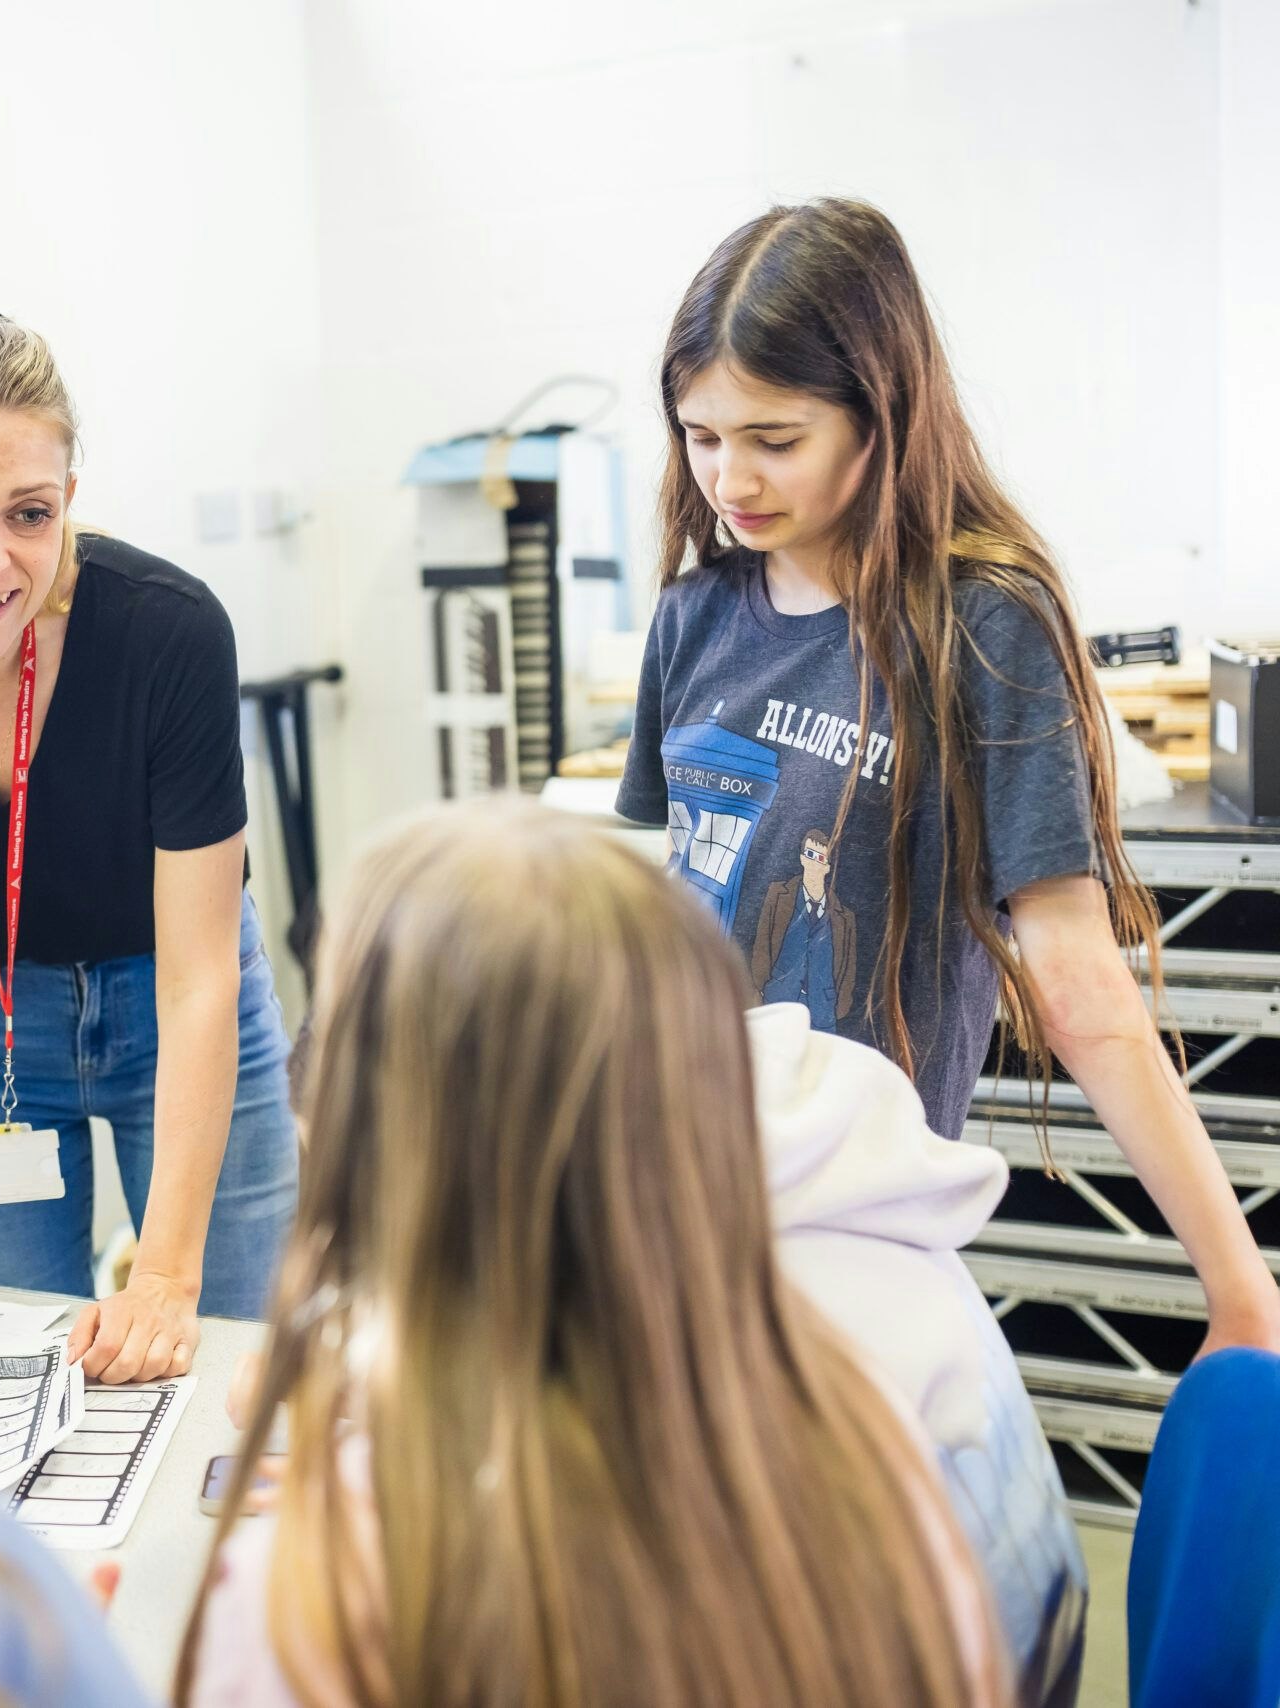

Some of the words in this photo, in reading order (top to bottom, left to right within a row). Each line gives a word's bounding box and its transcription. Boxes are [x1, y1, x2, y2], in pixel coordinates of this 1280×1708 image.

[22, 680, 30, 710] Theatre
[21, 711, 29, 727] Rep
[19, 728, 28, 760] Reading
[756, 699, 896, 786] ALLONS-Y!
[685, 767, 717, 781] PUBLIC
[686, 776, 712, 788] CALL
[720, 776, 752, 795] BOX
[14, 820, 22, 836] Rep
[12, 837, 21, 869] Reading
